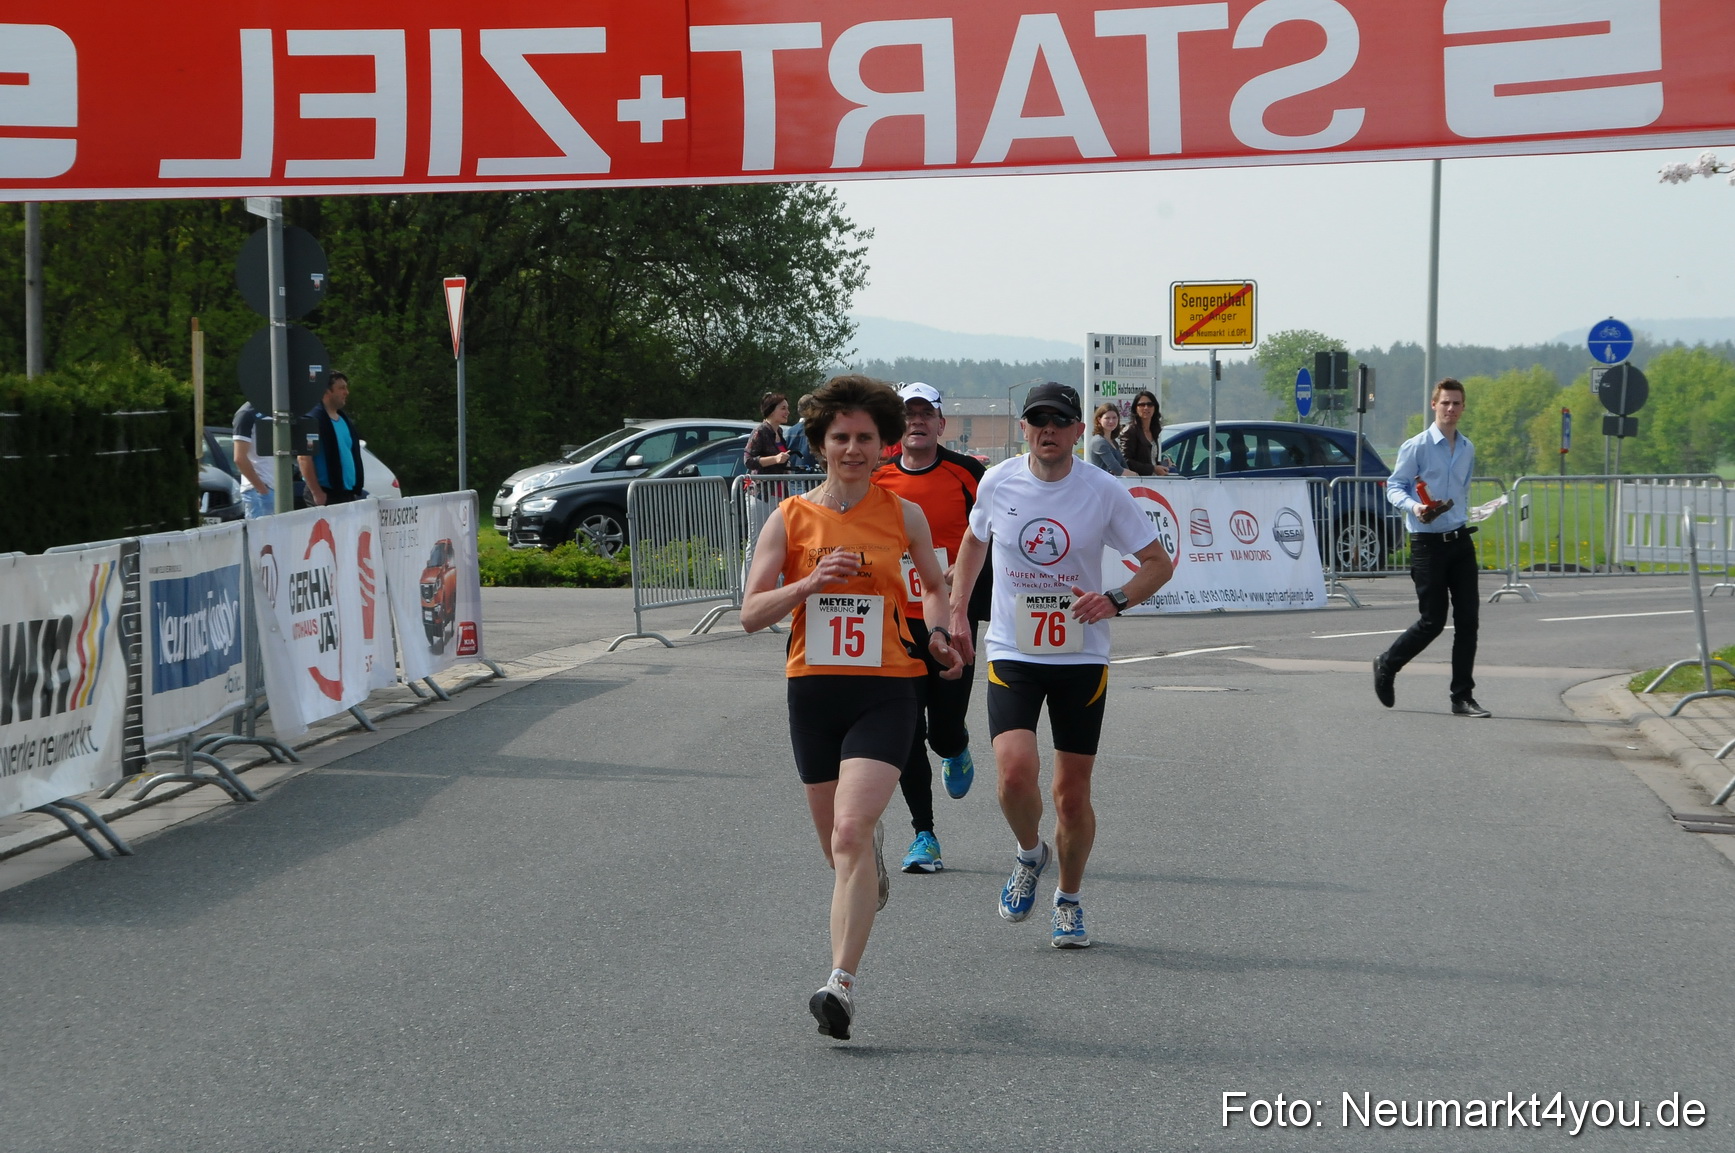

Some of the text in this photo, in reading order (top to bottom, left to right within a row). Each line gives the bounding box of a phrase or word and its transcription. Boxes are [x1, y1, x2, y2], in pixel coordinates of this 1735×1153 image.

[1181, 291, 1246, 311] Sengenthal
[1190, 312, 1237, 323] am Anger
[1101, 381, 1117, 397] SHB
[1234, 518, 1255, 537] KIA
[1189, 552, 1223, 562] SEAT
[1230, 550, 1271, 561] KIA MOTORS
[1058, 573, 1080, 582] HERZ
[819, 598, 854, 606] MEYER
[1026, 596, 1057, 604] MEYER
[1031, 611, 1066, 647] 76
[829, 616, 865, 657] 15
[37, 719, 99, 768] neumarkt
